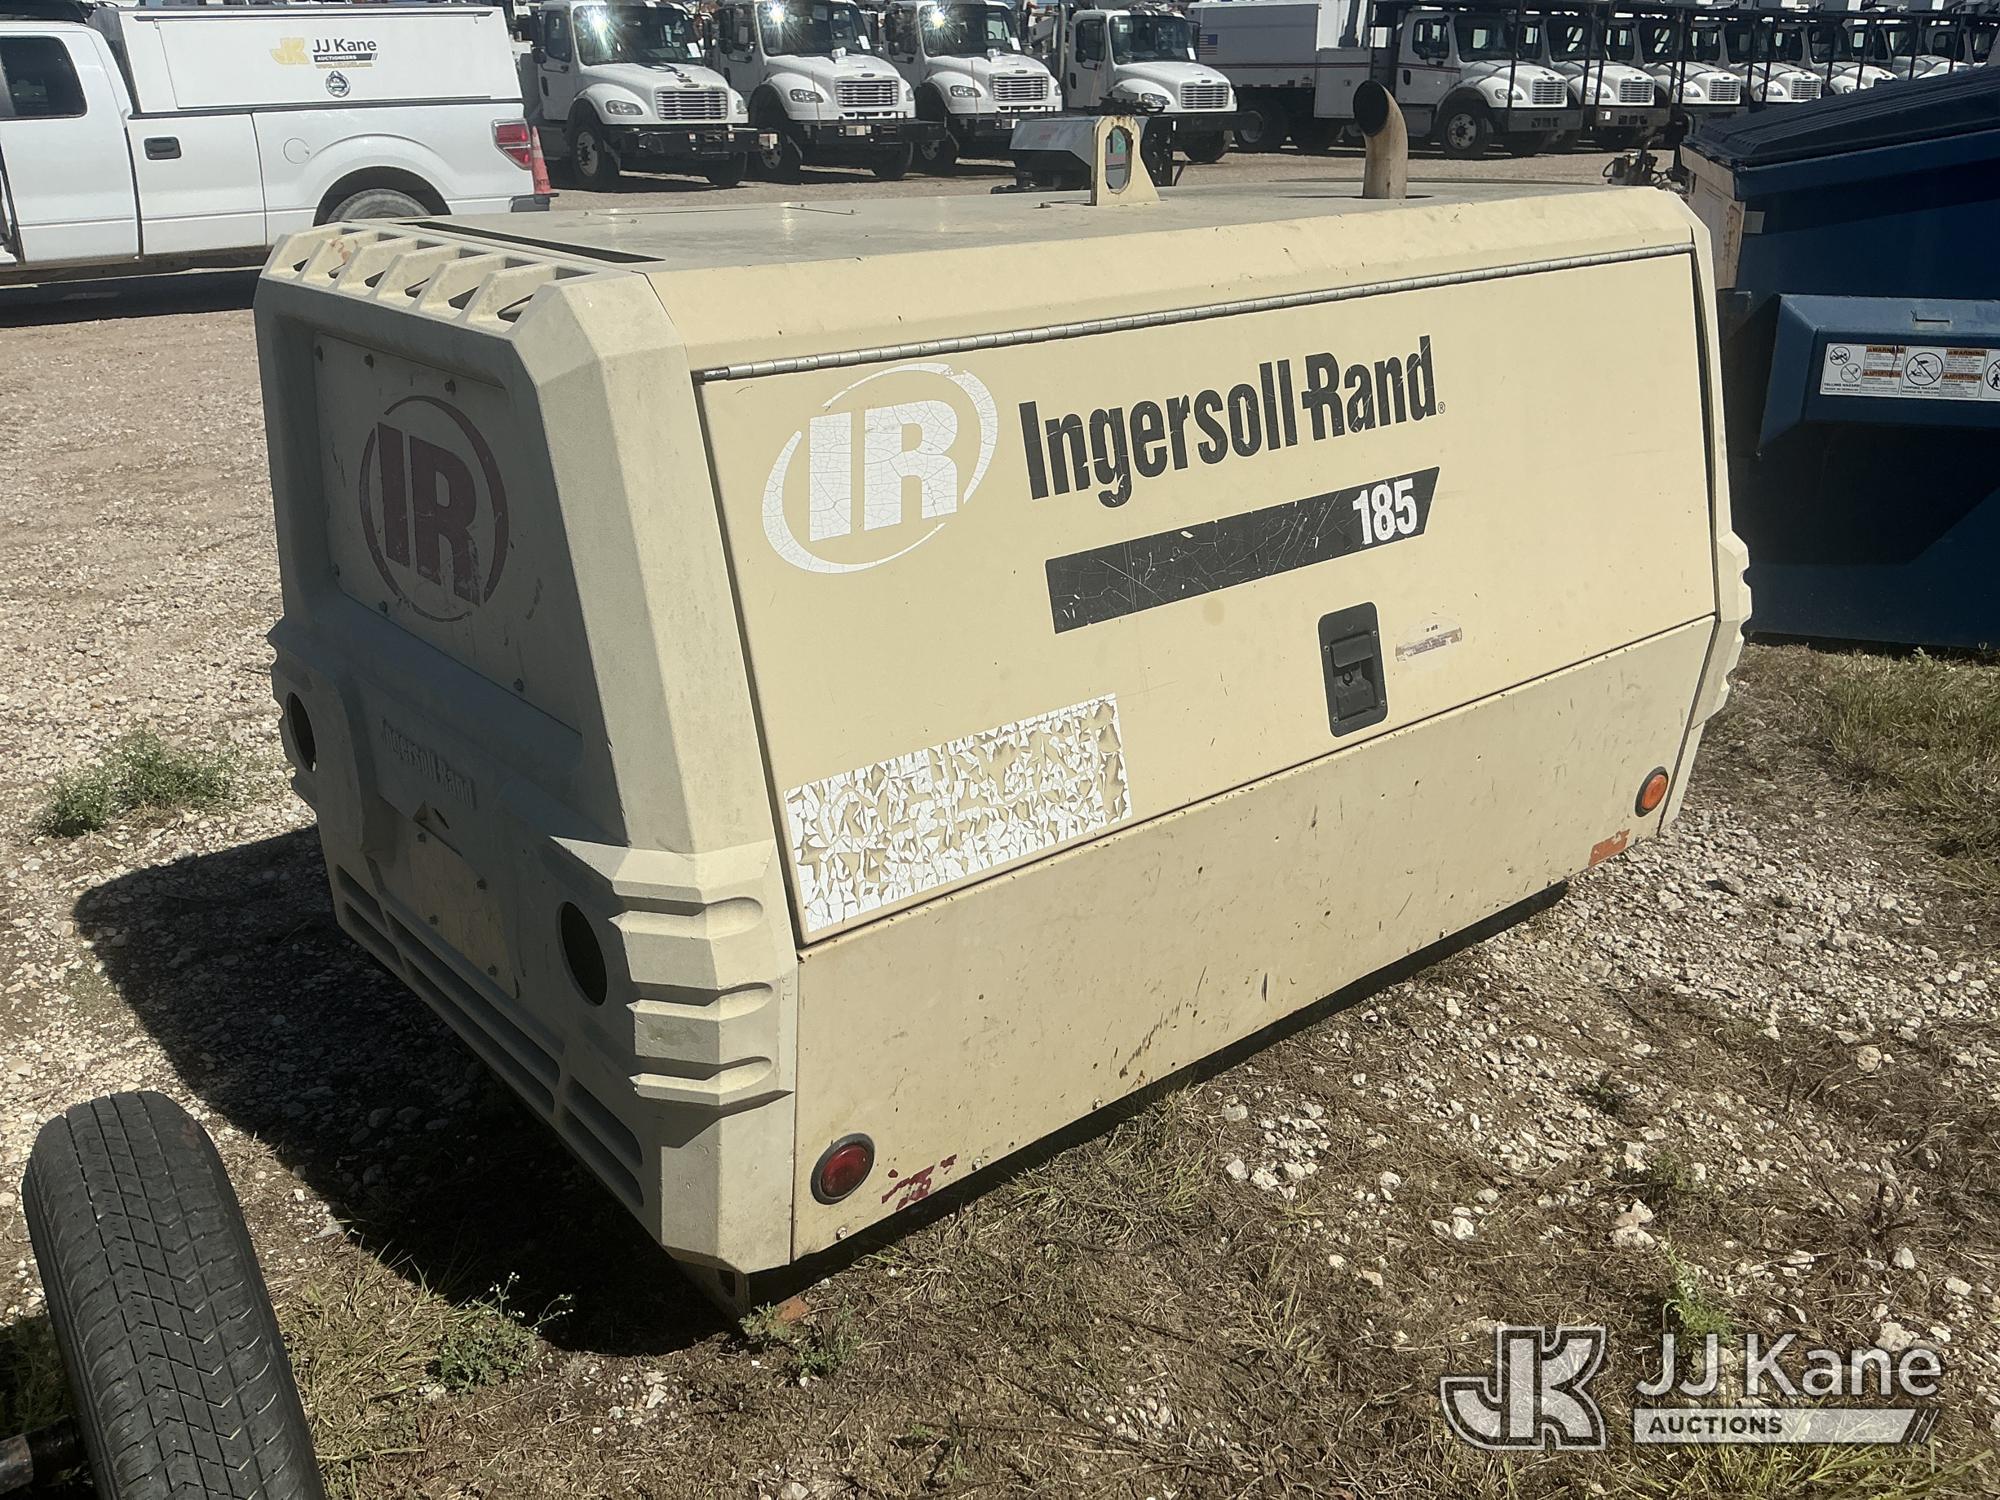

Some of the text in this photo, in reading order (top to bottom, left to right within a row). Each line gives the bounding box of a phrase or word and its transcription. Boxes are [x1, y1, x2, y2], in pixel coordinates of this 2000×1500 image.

[312, 38, 377, 53] JJ Kane
[377, 422, 481, 608] IR
[809, 400, 957, 542] IR
[1352, 477, 1418, 545] 185
